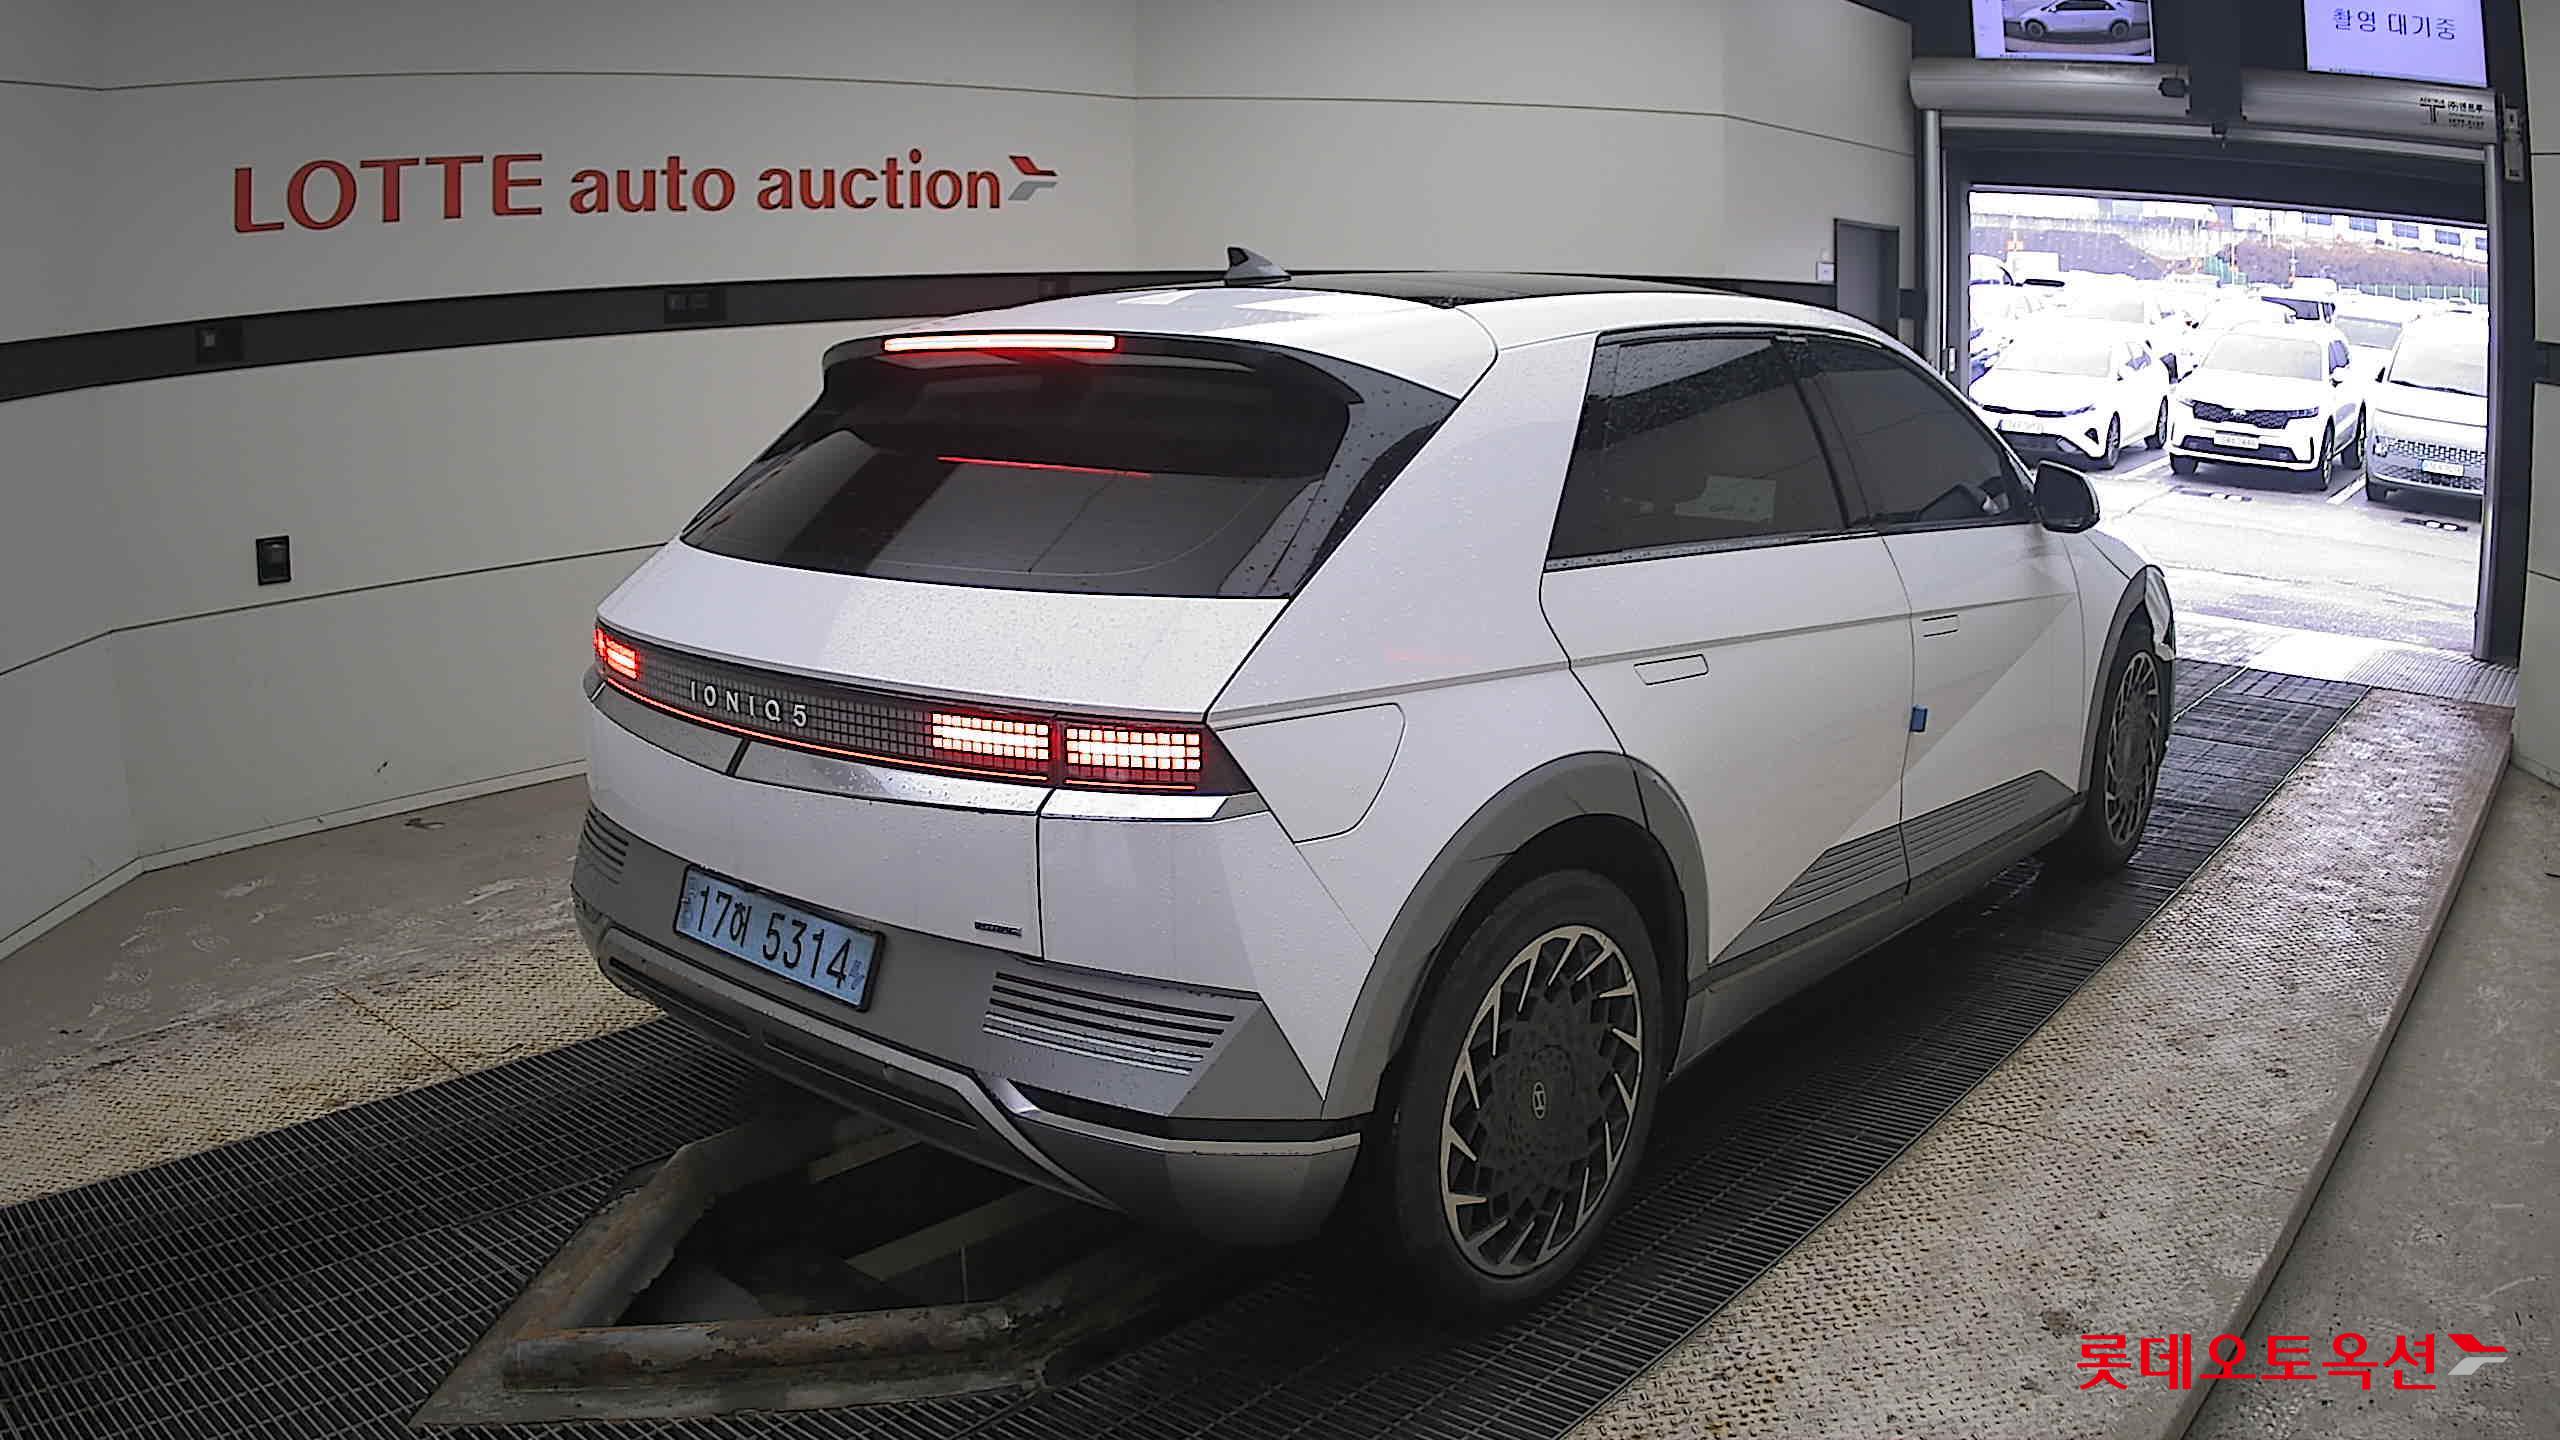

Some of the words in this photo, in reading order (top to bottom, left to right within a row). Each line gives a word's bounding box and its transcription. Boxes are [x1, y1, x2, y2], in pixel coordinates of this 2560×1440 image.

[2334, 8, 2376, 32] 촬영
[2388, 13, 2456, 40] 대기중
[234, 153, 543, 233] LOTTE
[568, 155, 736, 214] auto
[756, 148, 1001, 210] auction
[690, 681, 782, 722] IONIQ
[793, 704, 807, 728] 5
[698, 885, 752, 948] 17허
[762, 912, 852, 989] 5314
